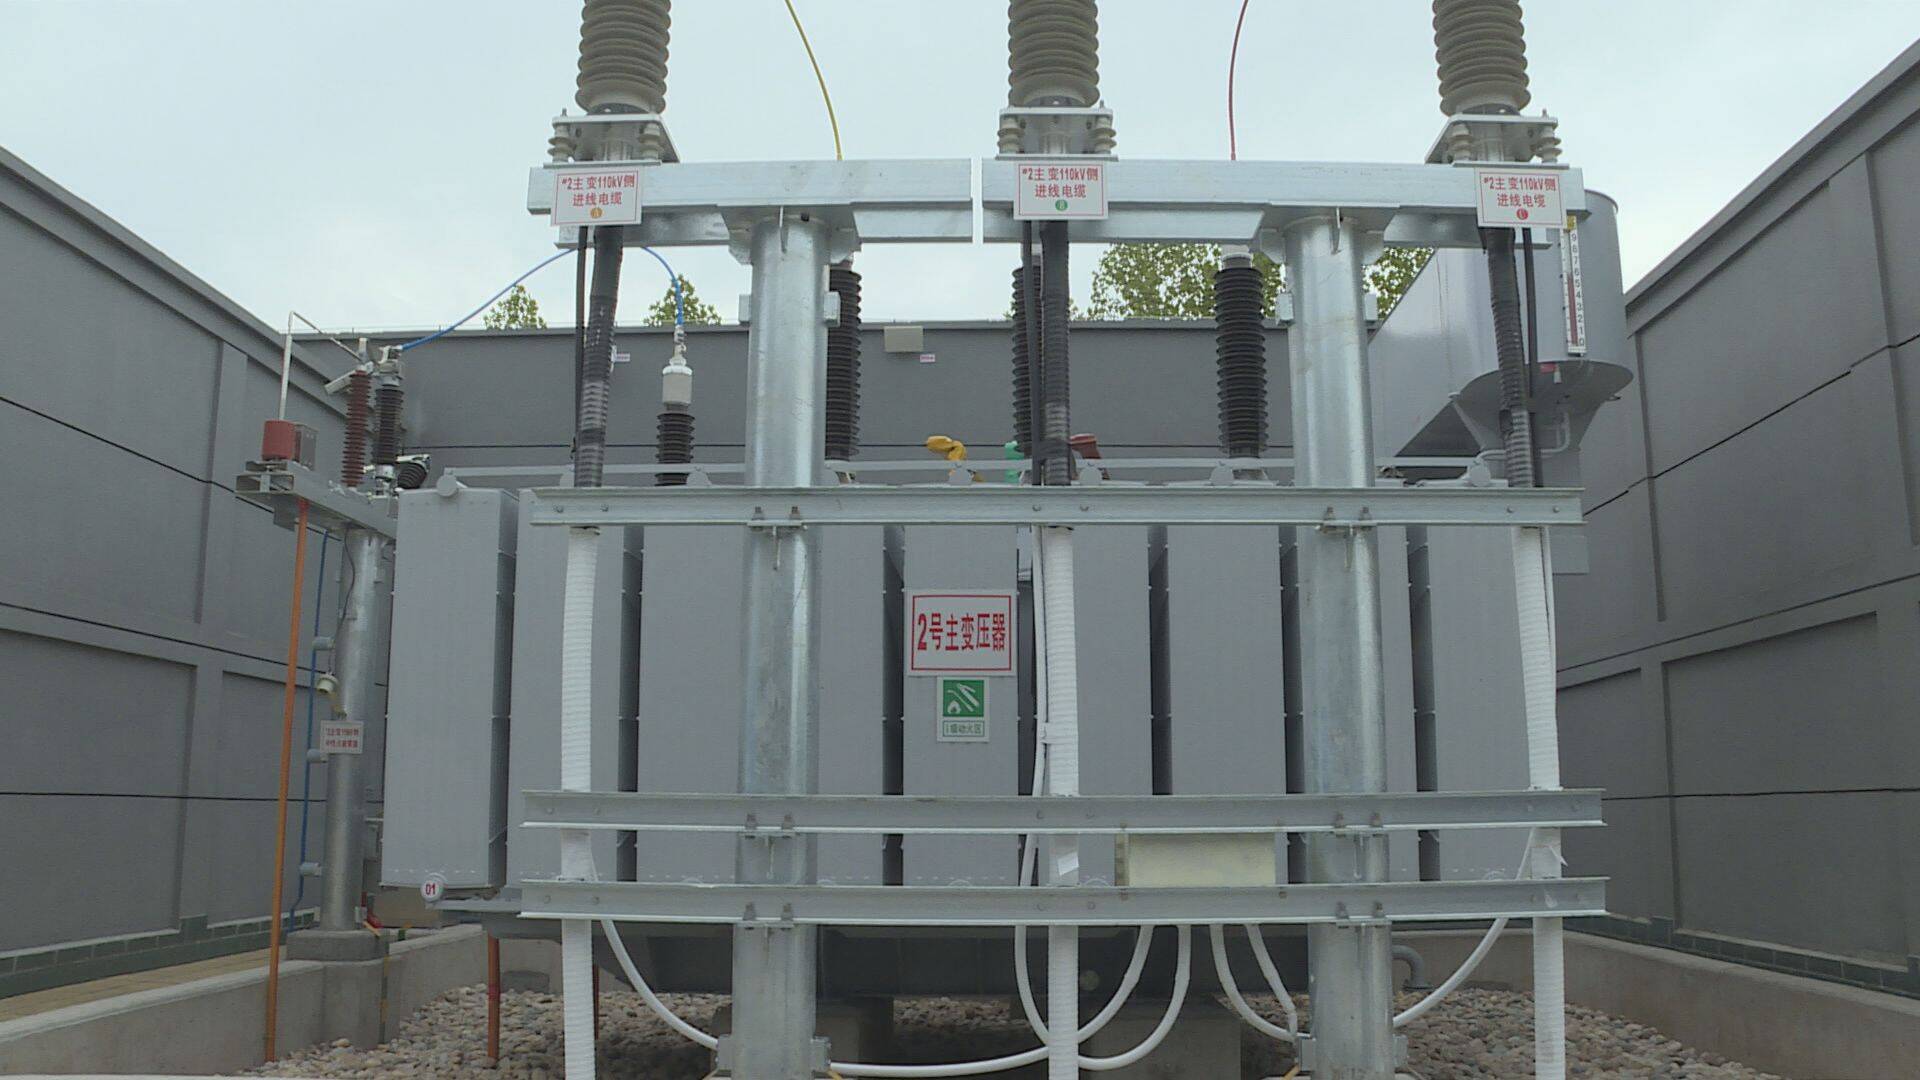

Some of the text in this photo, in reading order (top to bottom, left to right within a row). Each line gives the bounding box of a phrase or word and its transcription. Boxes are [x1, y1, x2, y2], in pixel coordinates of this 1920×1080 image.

[1034, 183, 1087, 198] 进线电缆
[572, 191, 623, 206] 进线电缆
[1496, 192, 1546, 208] 进线电缆
[917, 613, 1006, 651] 2号主变压器
[425, 883, 436, 895] 01
